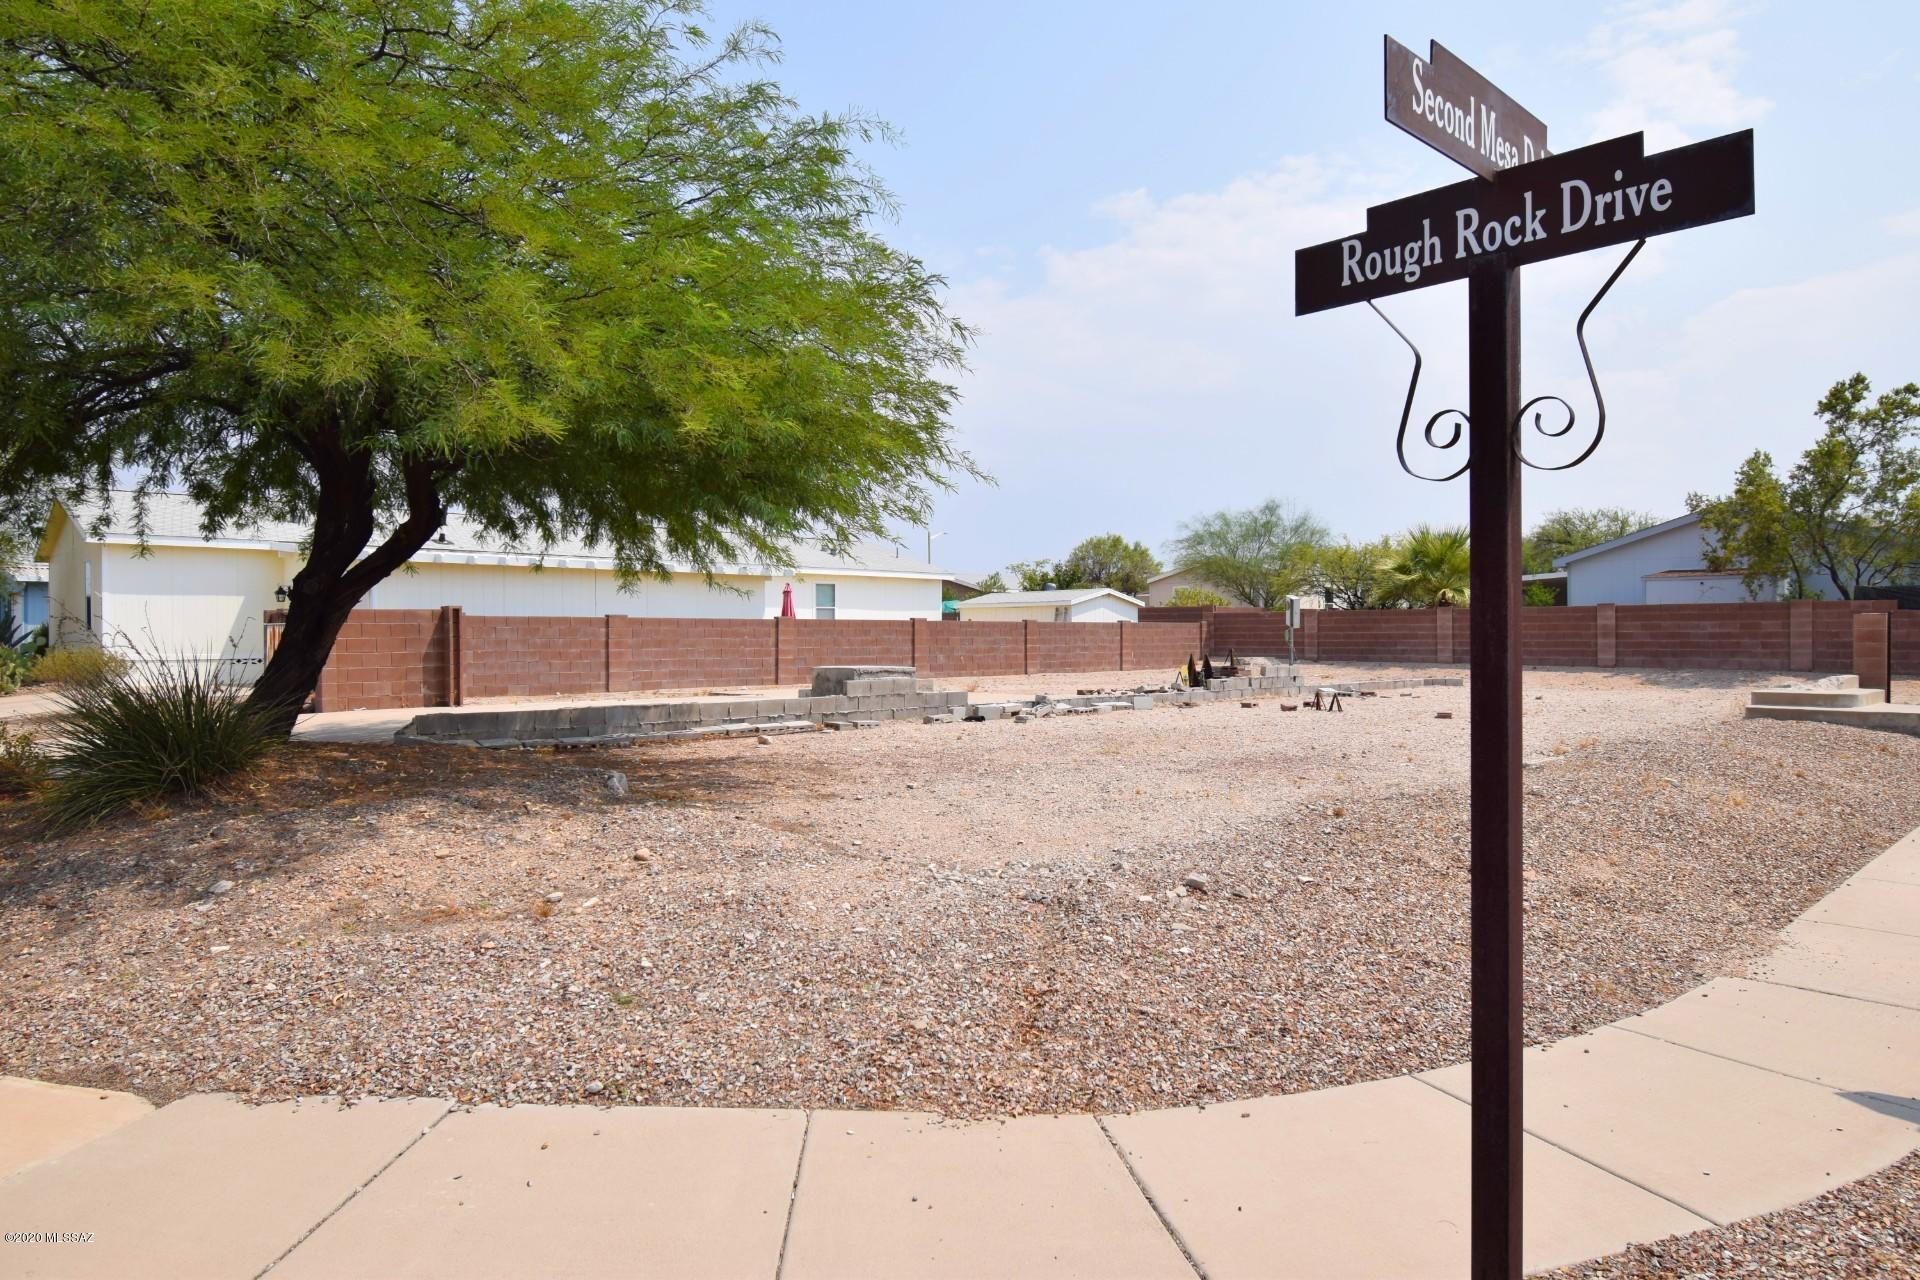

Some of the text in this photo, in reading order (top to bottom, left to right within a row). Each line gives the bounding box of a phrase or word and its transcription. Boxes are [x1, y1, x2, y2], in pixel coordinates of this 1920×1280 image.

[1412, 58, 1519, 169] Second Mesa
[1340, 169, 1673, 287] Rough Rock Drive
